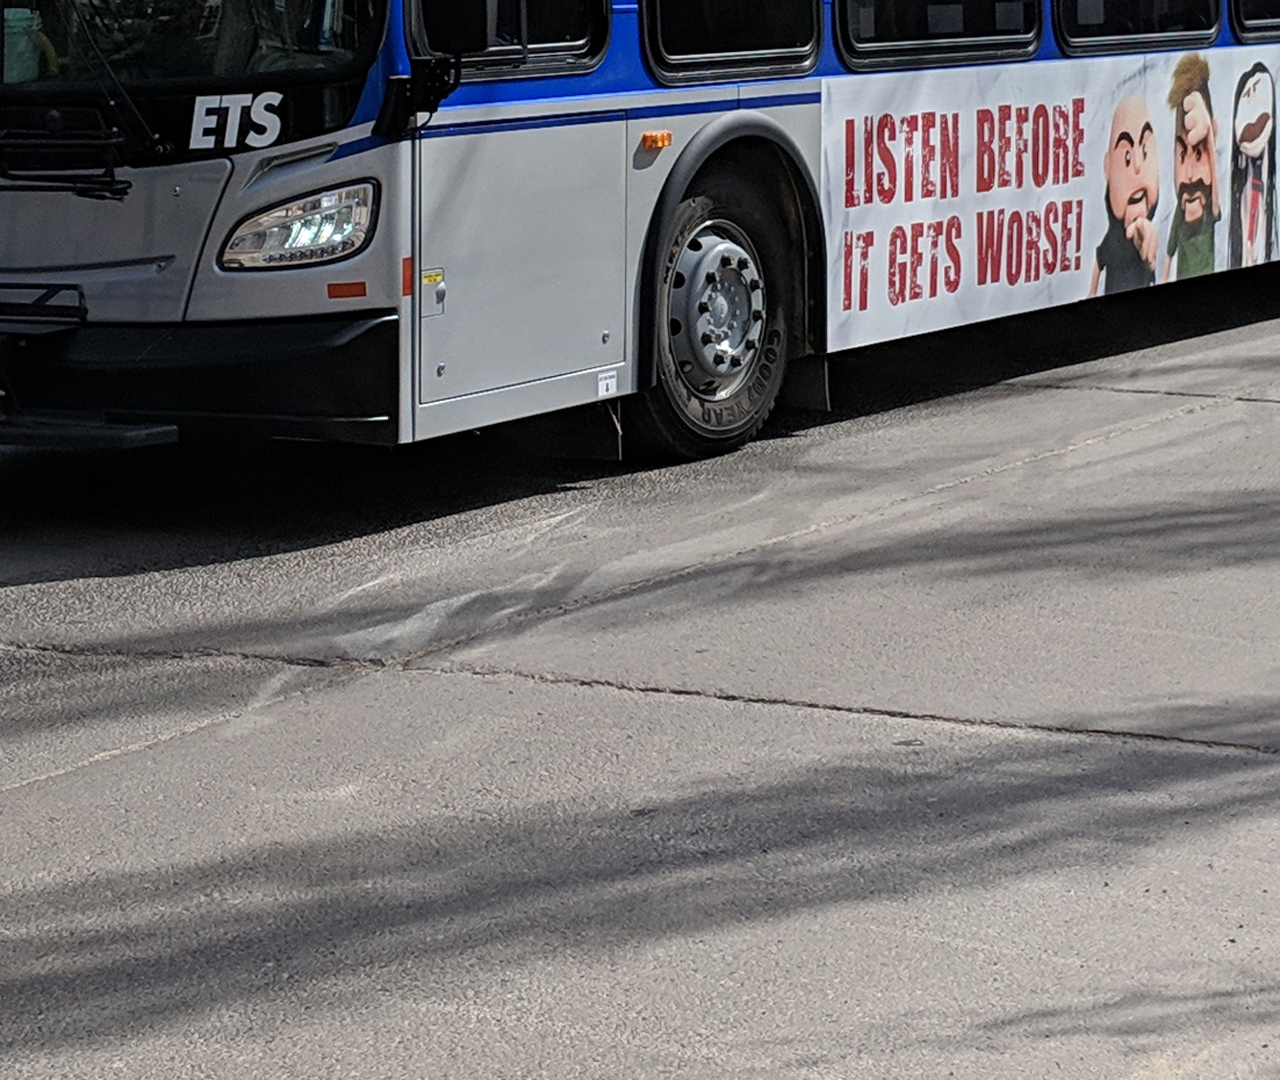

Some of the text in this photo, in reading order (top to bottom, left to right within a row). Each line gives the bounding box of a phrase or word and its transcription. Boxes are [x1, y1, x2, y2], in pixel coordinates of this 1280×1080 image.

[188, 91, 284, 150] ETS
[845, 98, 1085, 208] LISTEN BEFORE
[842, 199, 1083, 311] IT GETS WORSE!
